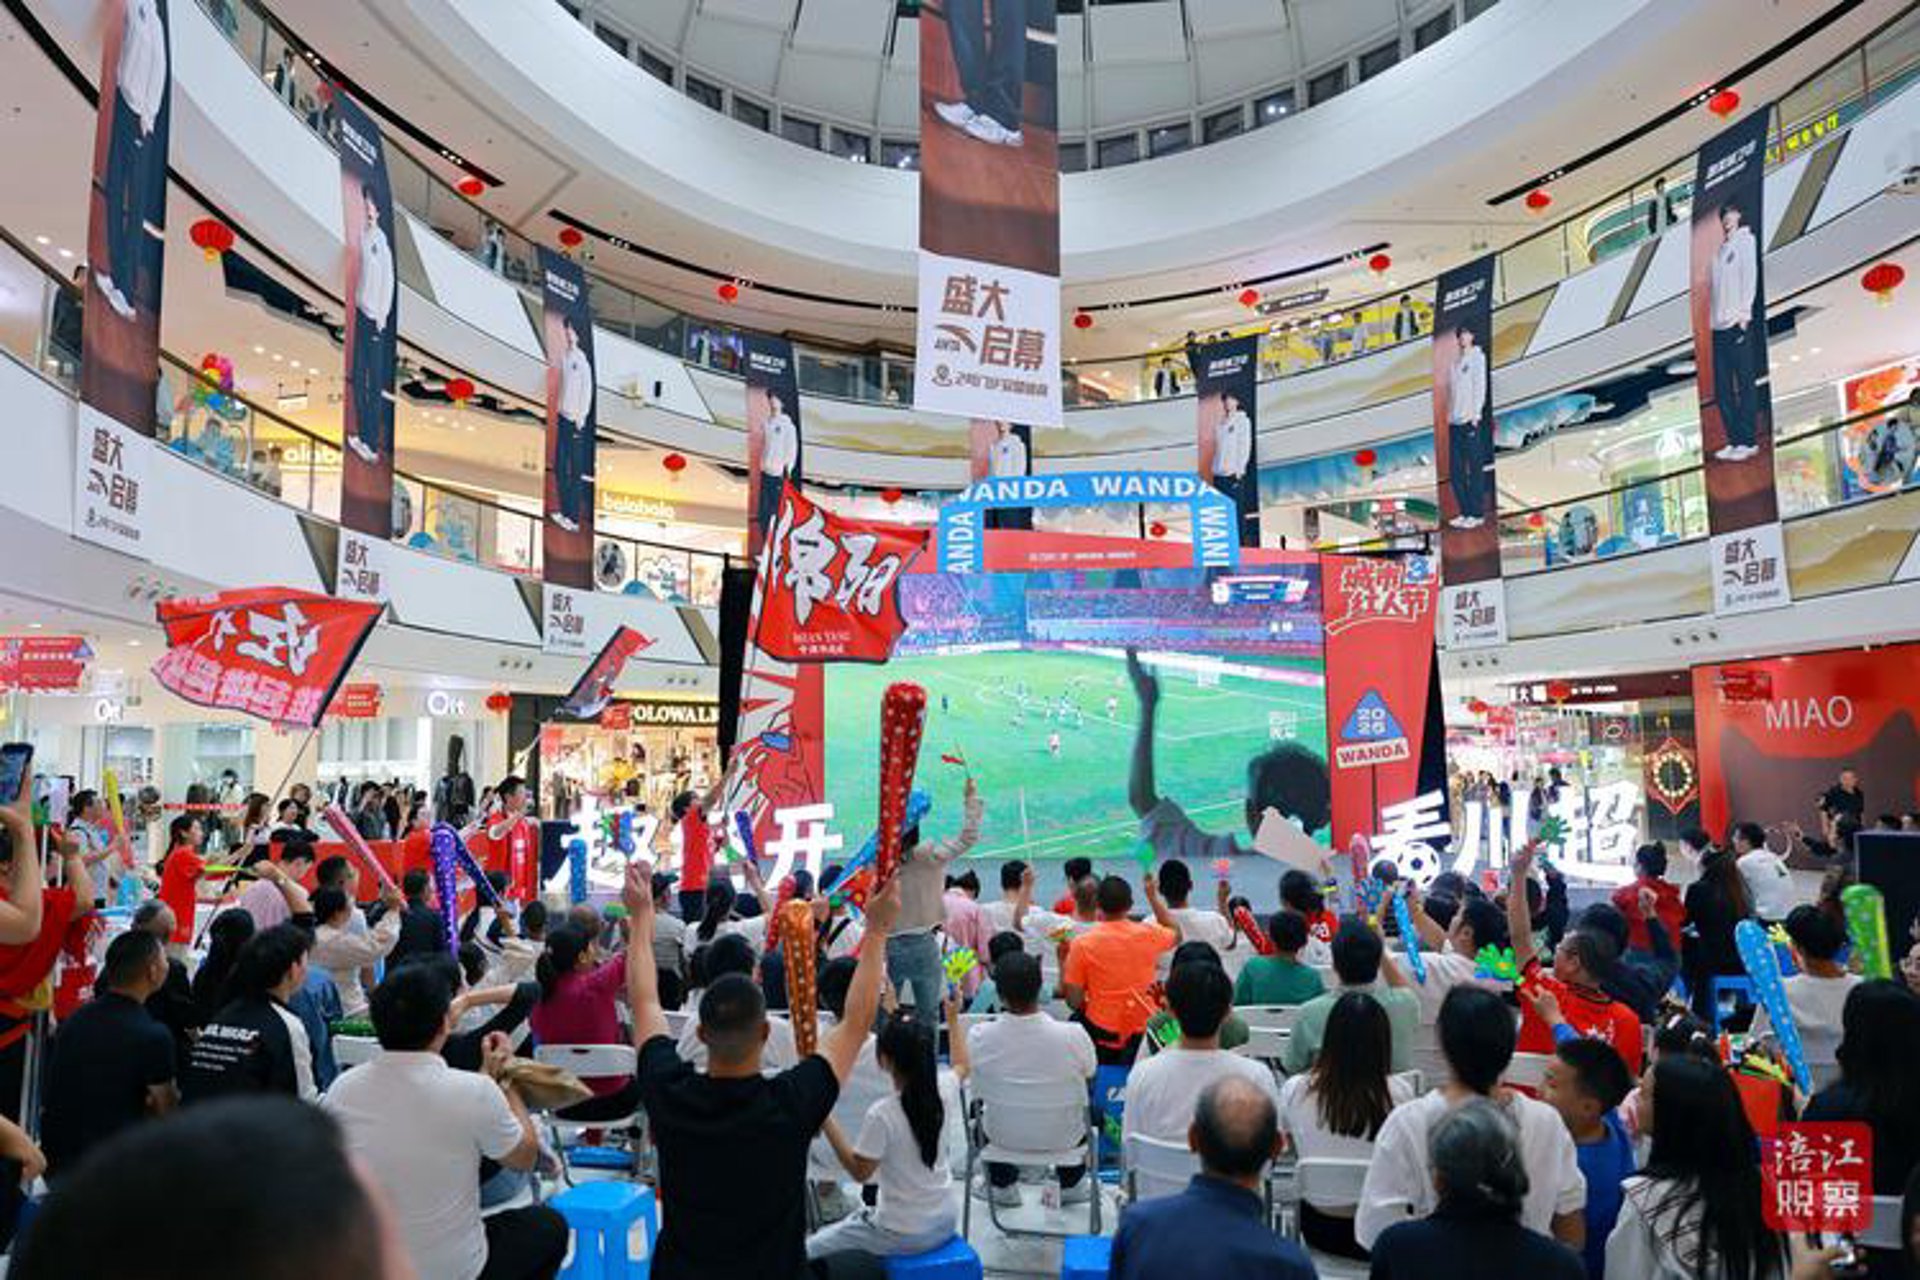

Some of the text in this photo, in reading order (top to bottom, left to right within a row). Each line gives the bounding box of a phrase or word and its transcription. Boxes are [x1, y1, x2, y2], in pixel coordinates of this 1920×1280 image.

[942, 274, 1010, 321] 盛大
[981, 325, 1046, 371] 启幕
[92, 427, 124, 471] 盛大
[1090, 475, 1224, 498] WANDA
[1725, 538, 1757, 565] 盛大
[629, 704, 719, 723] OLOWAL
[1356, 708, 1386, 721] 20
[1764, 695, 1853, 730] MIAO
[1356, 721, 1387, 735] 26
[1338, 742, 1405, 764] WANDA
